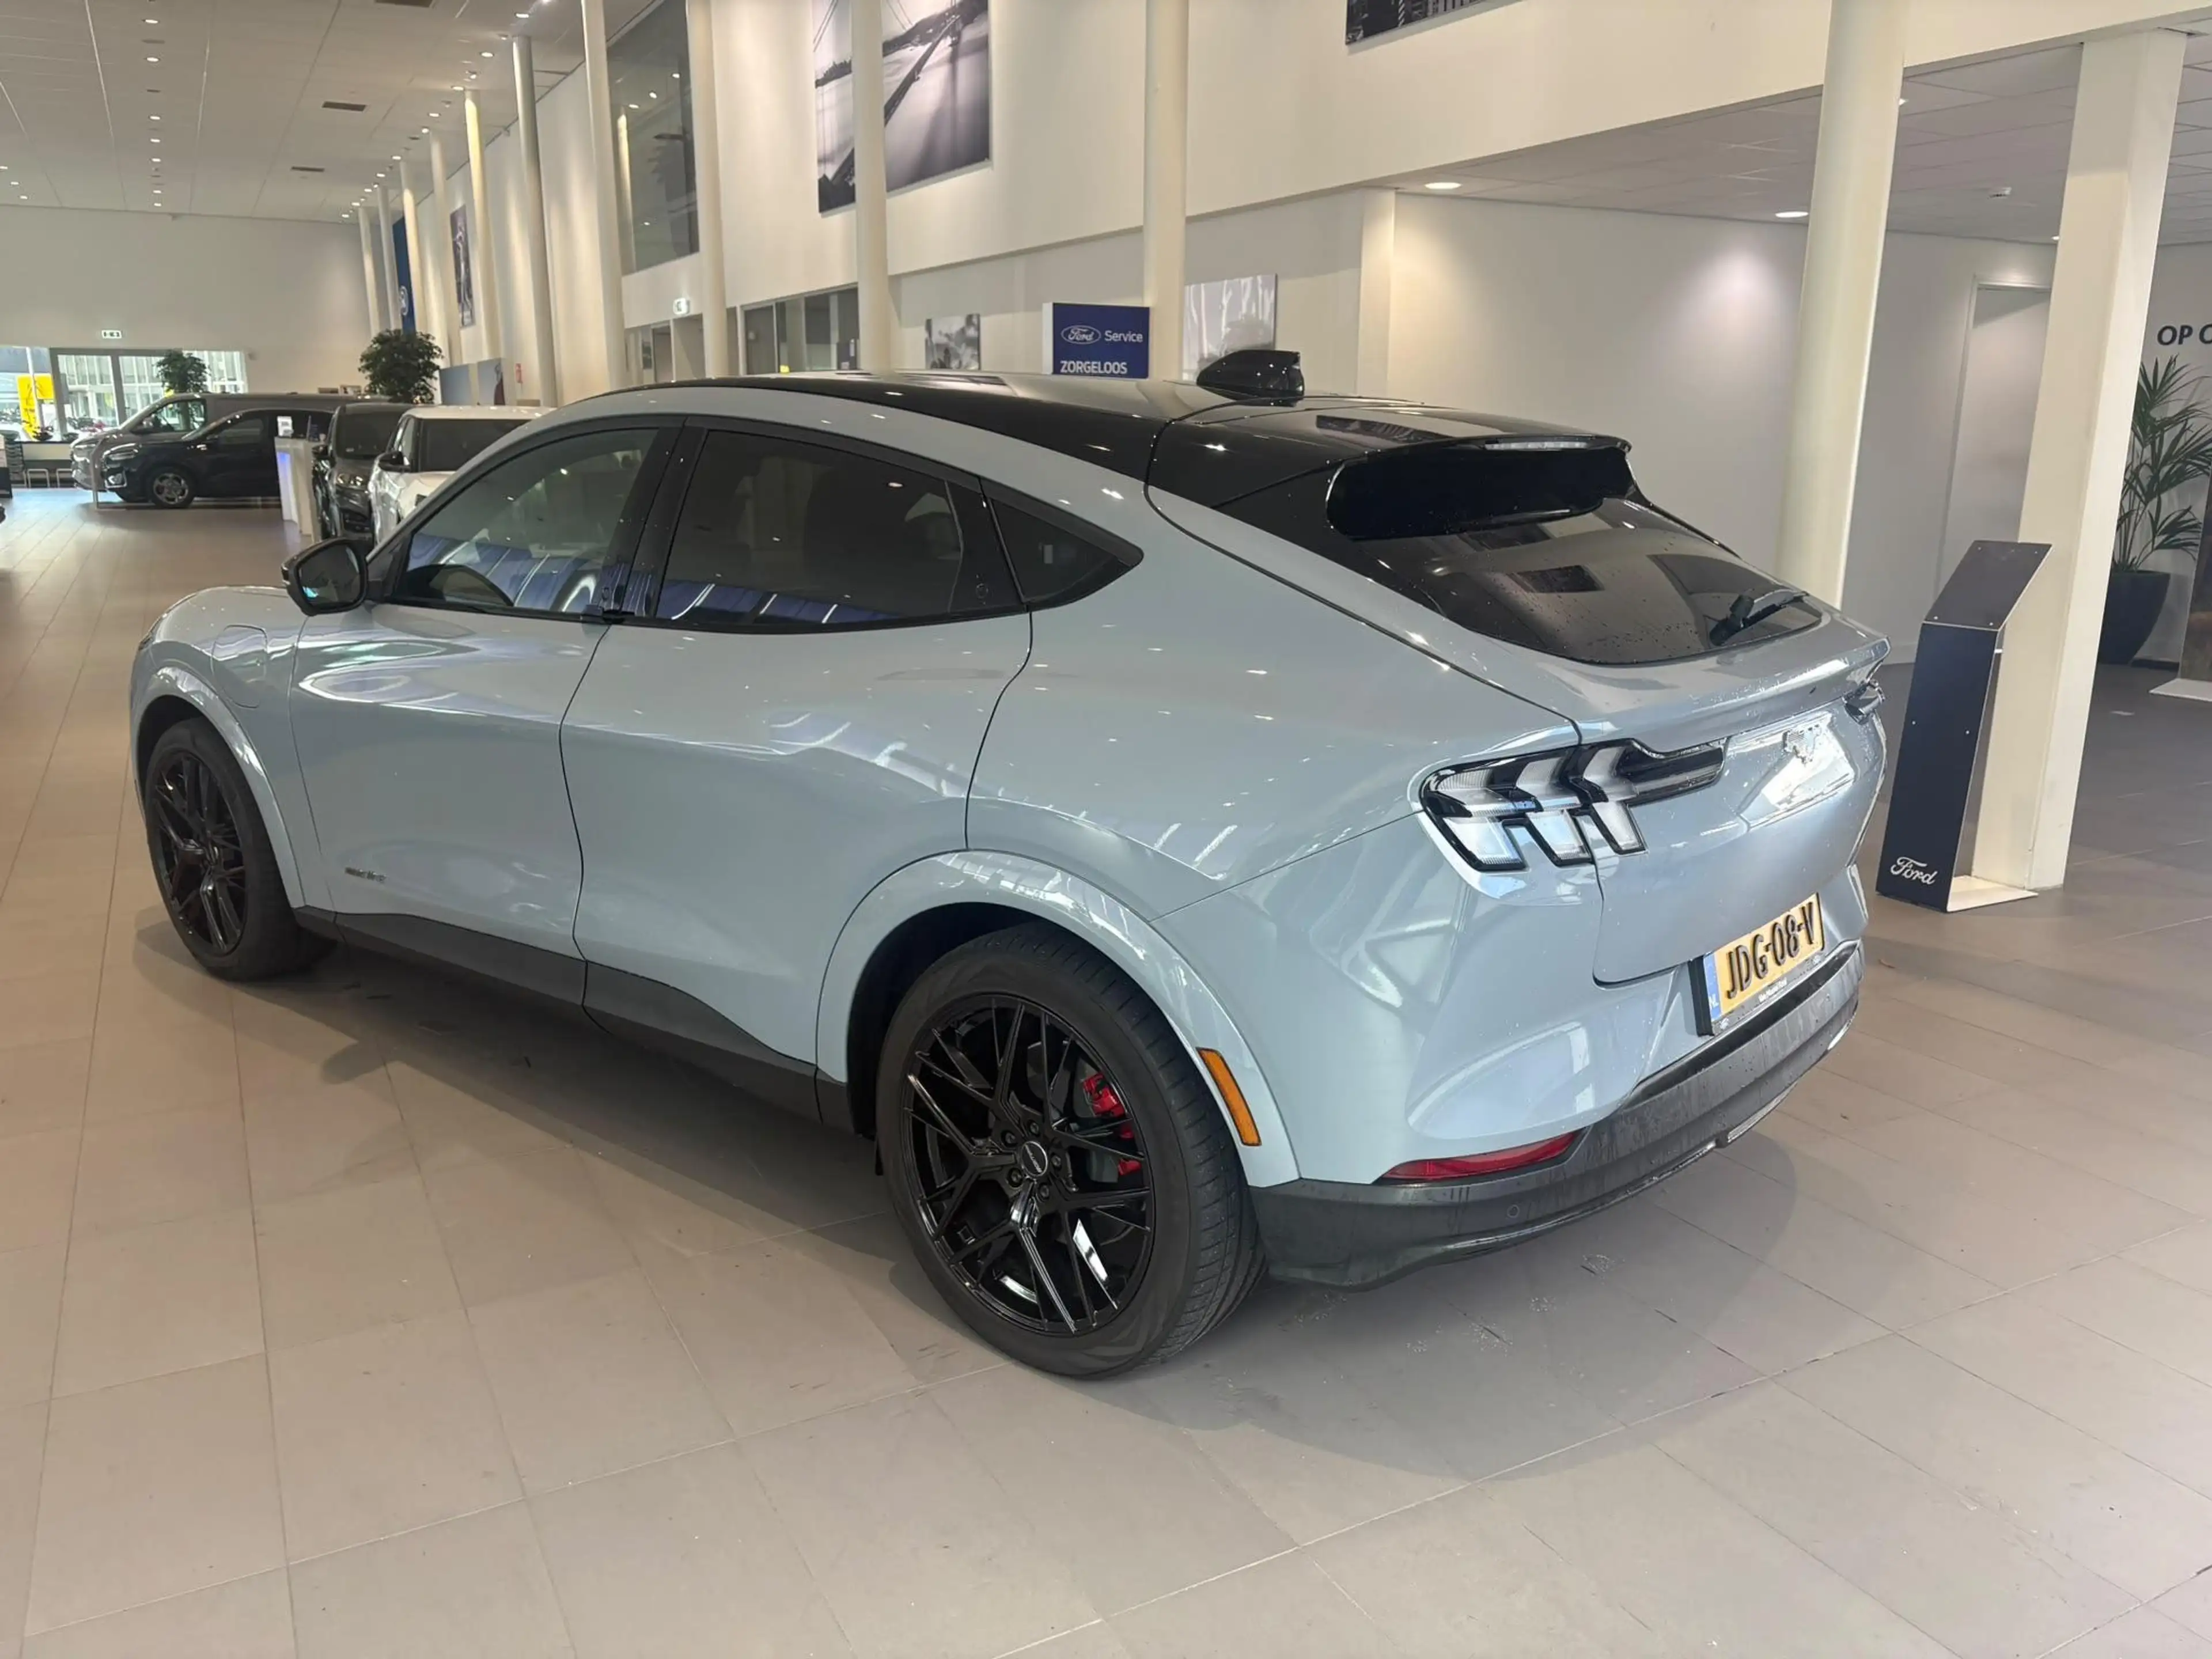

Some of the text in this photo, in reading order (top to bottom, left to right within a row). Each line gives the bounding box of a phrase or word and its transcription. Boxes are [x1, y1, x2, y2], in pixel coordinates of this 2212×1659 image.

[1067, 327, 1143, 343] Ford Service
[2157, 325, 2193, 346] OP
[1060, 360, 1128, 374] ZORGELOOS
[1890, 857, 1938, 885] Ford
[1726, 902, 1815, 999] JDG-08-V
[1709, 994, 1719, 1009] NL
